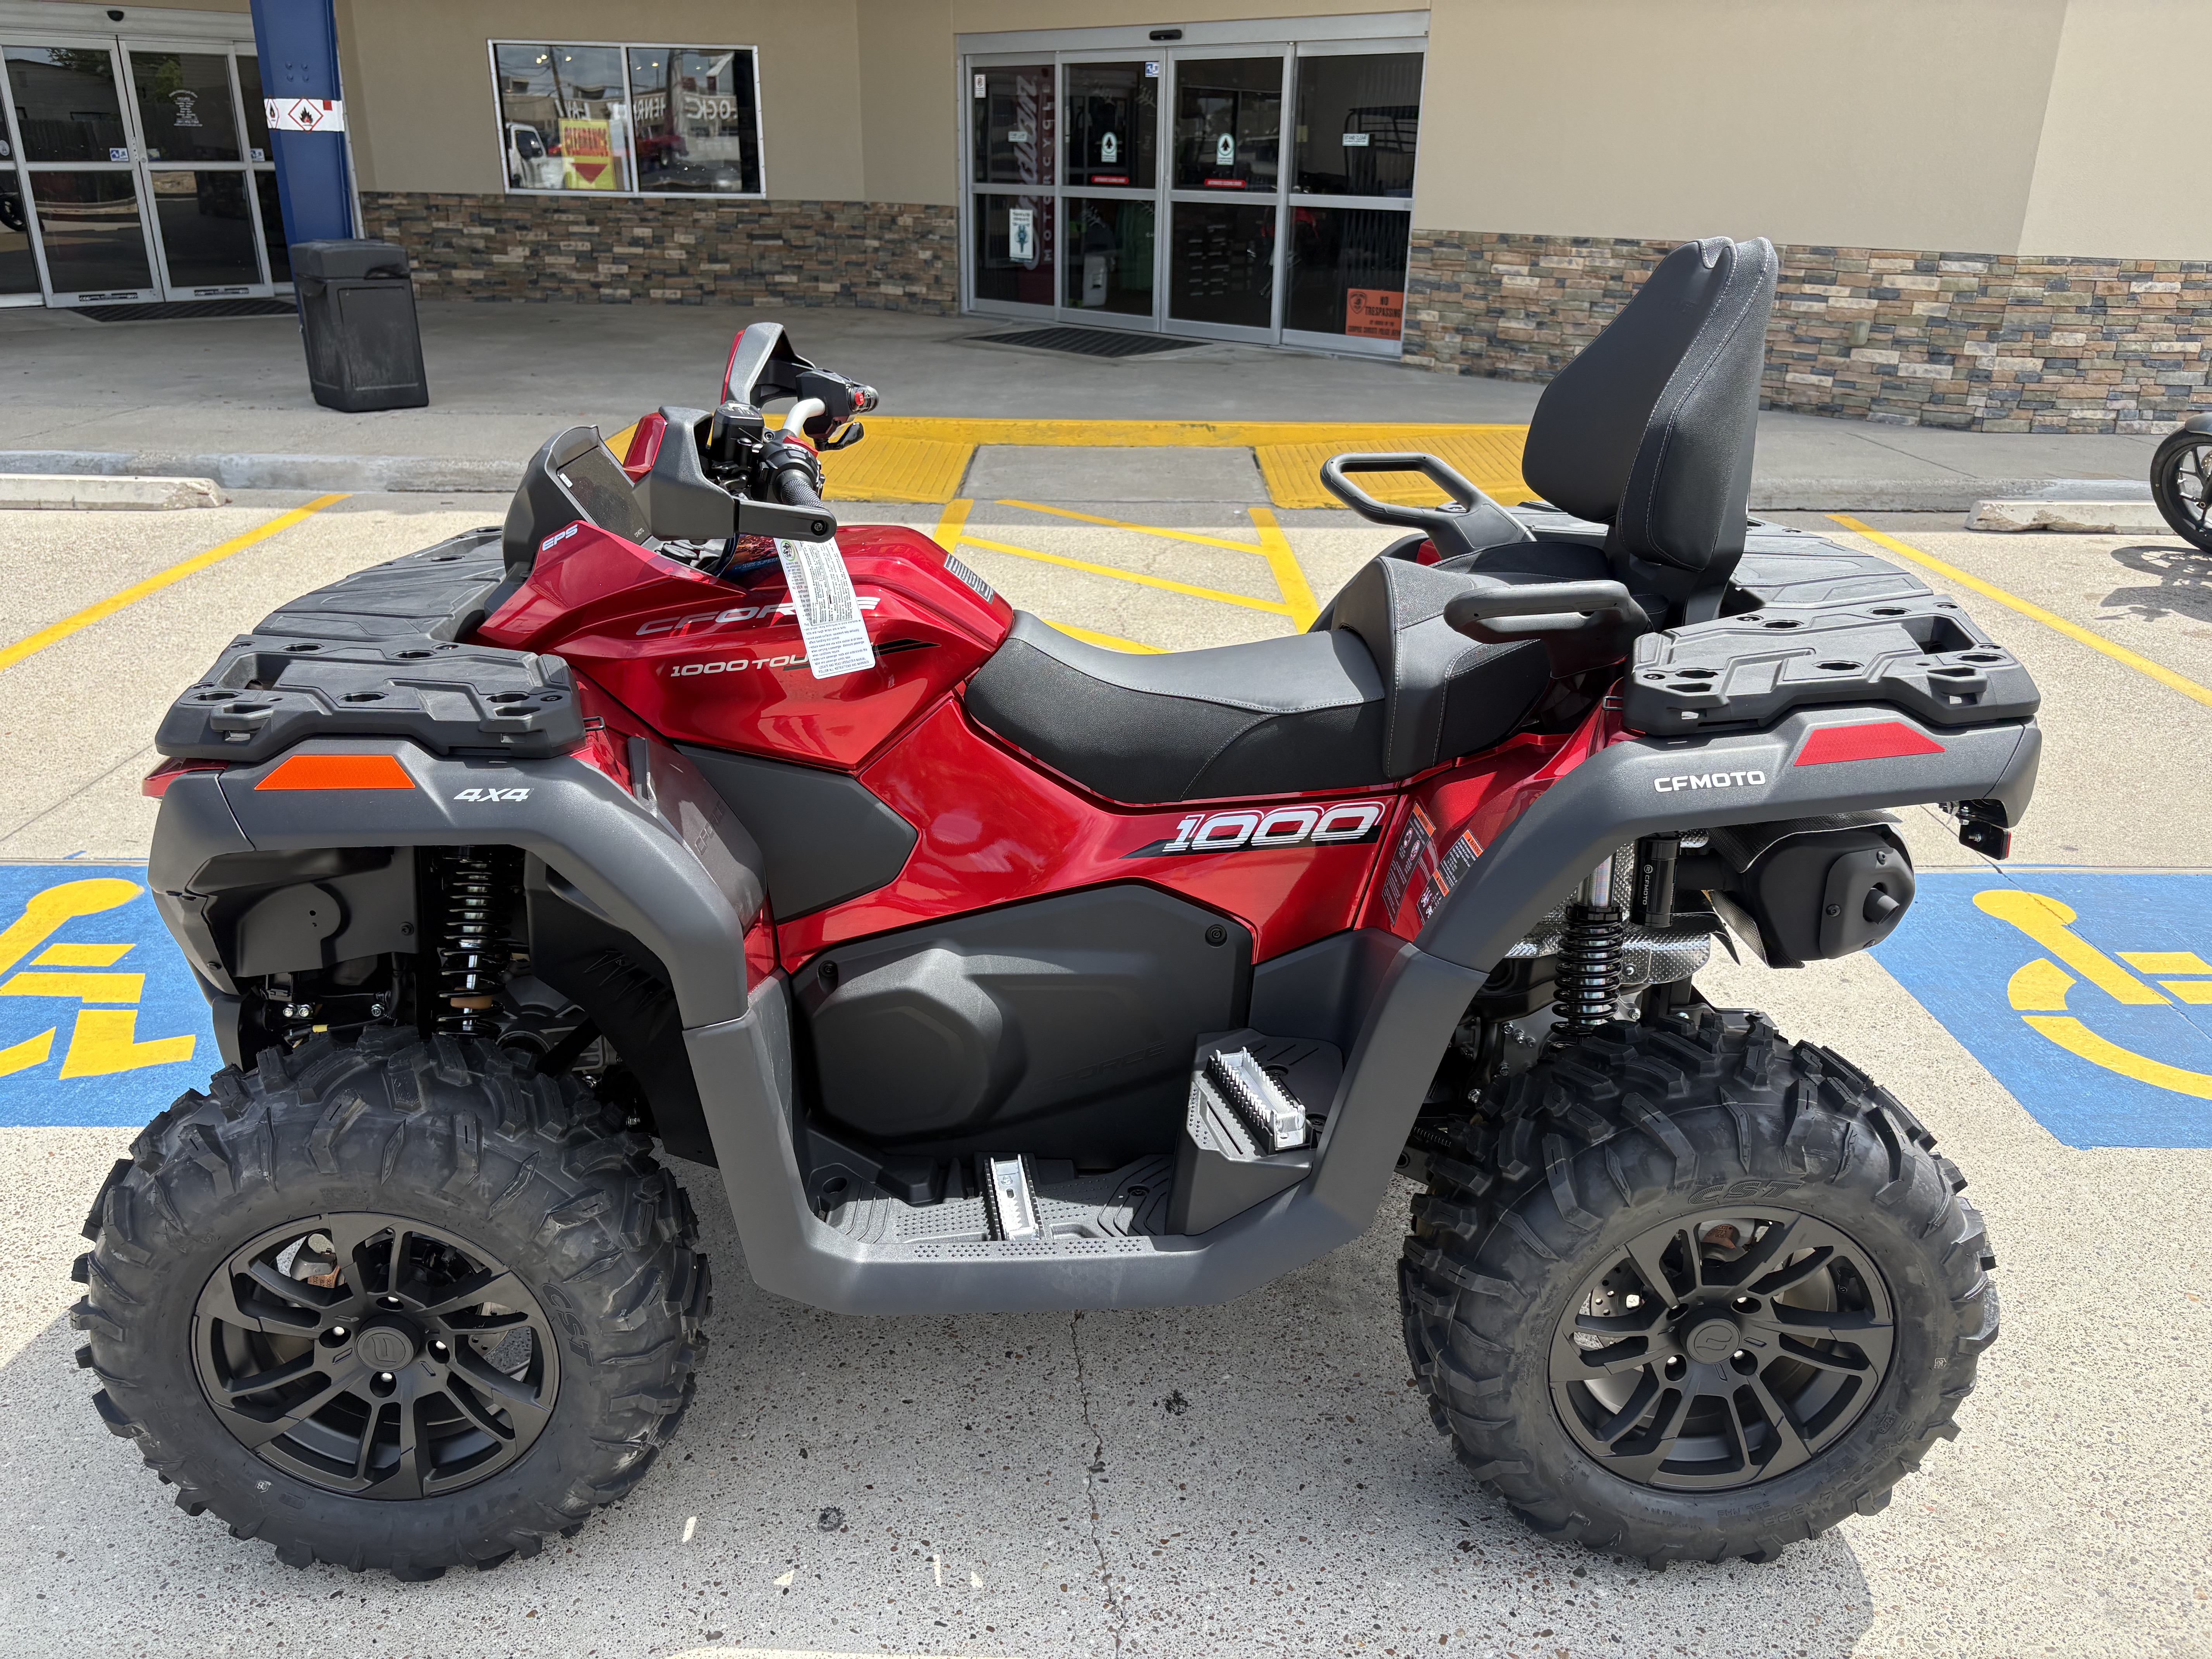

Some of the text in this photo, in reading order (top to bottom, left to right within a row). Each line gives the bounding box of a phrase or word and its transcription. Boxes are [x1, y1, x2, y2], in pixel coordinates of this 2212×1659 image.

[1365, 306, 1401, 318] TRESPASSING
[1380, 296, 1389, 306] NO
[543, 524, 578, 551] EPS
[636, 597, 881, 635] CFORE
[670, 659, 749, 677] 1000
[1654, 771, 1765, 792] CFMOTO
[1162, 802, 1385, 852] 1000
[1471, 839, 1481, 854] WARNING
[1688, 1180, 1804, 1205] CST
[541, 1283, 594, 1369] CST
